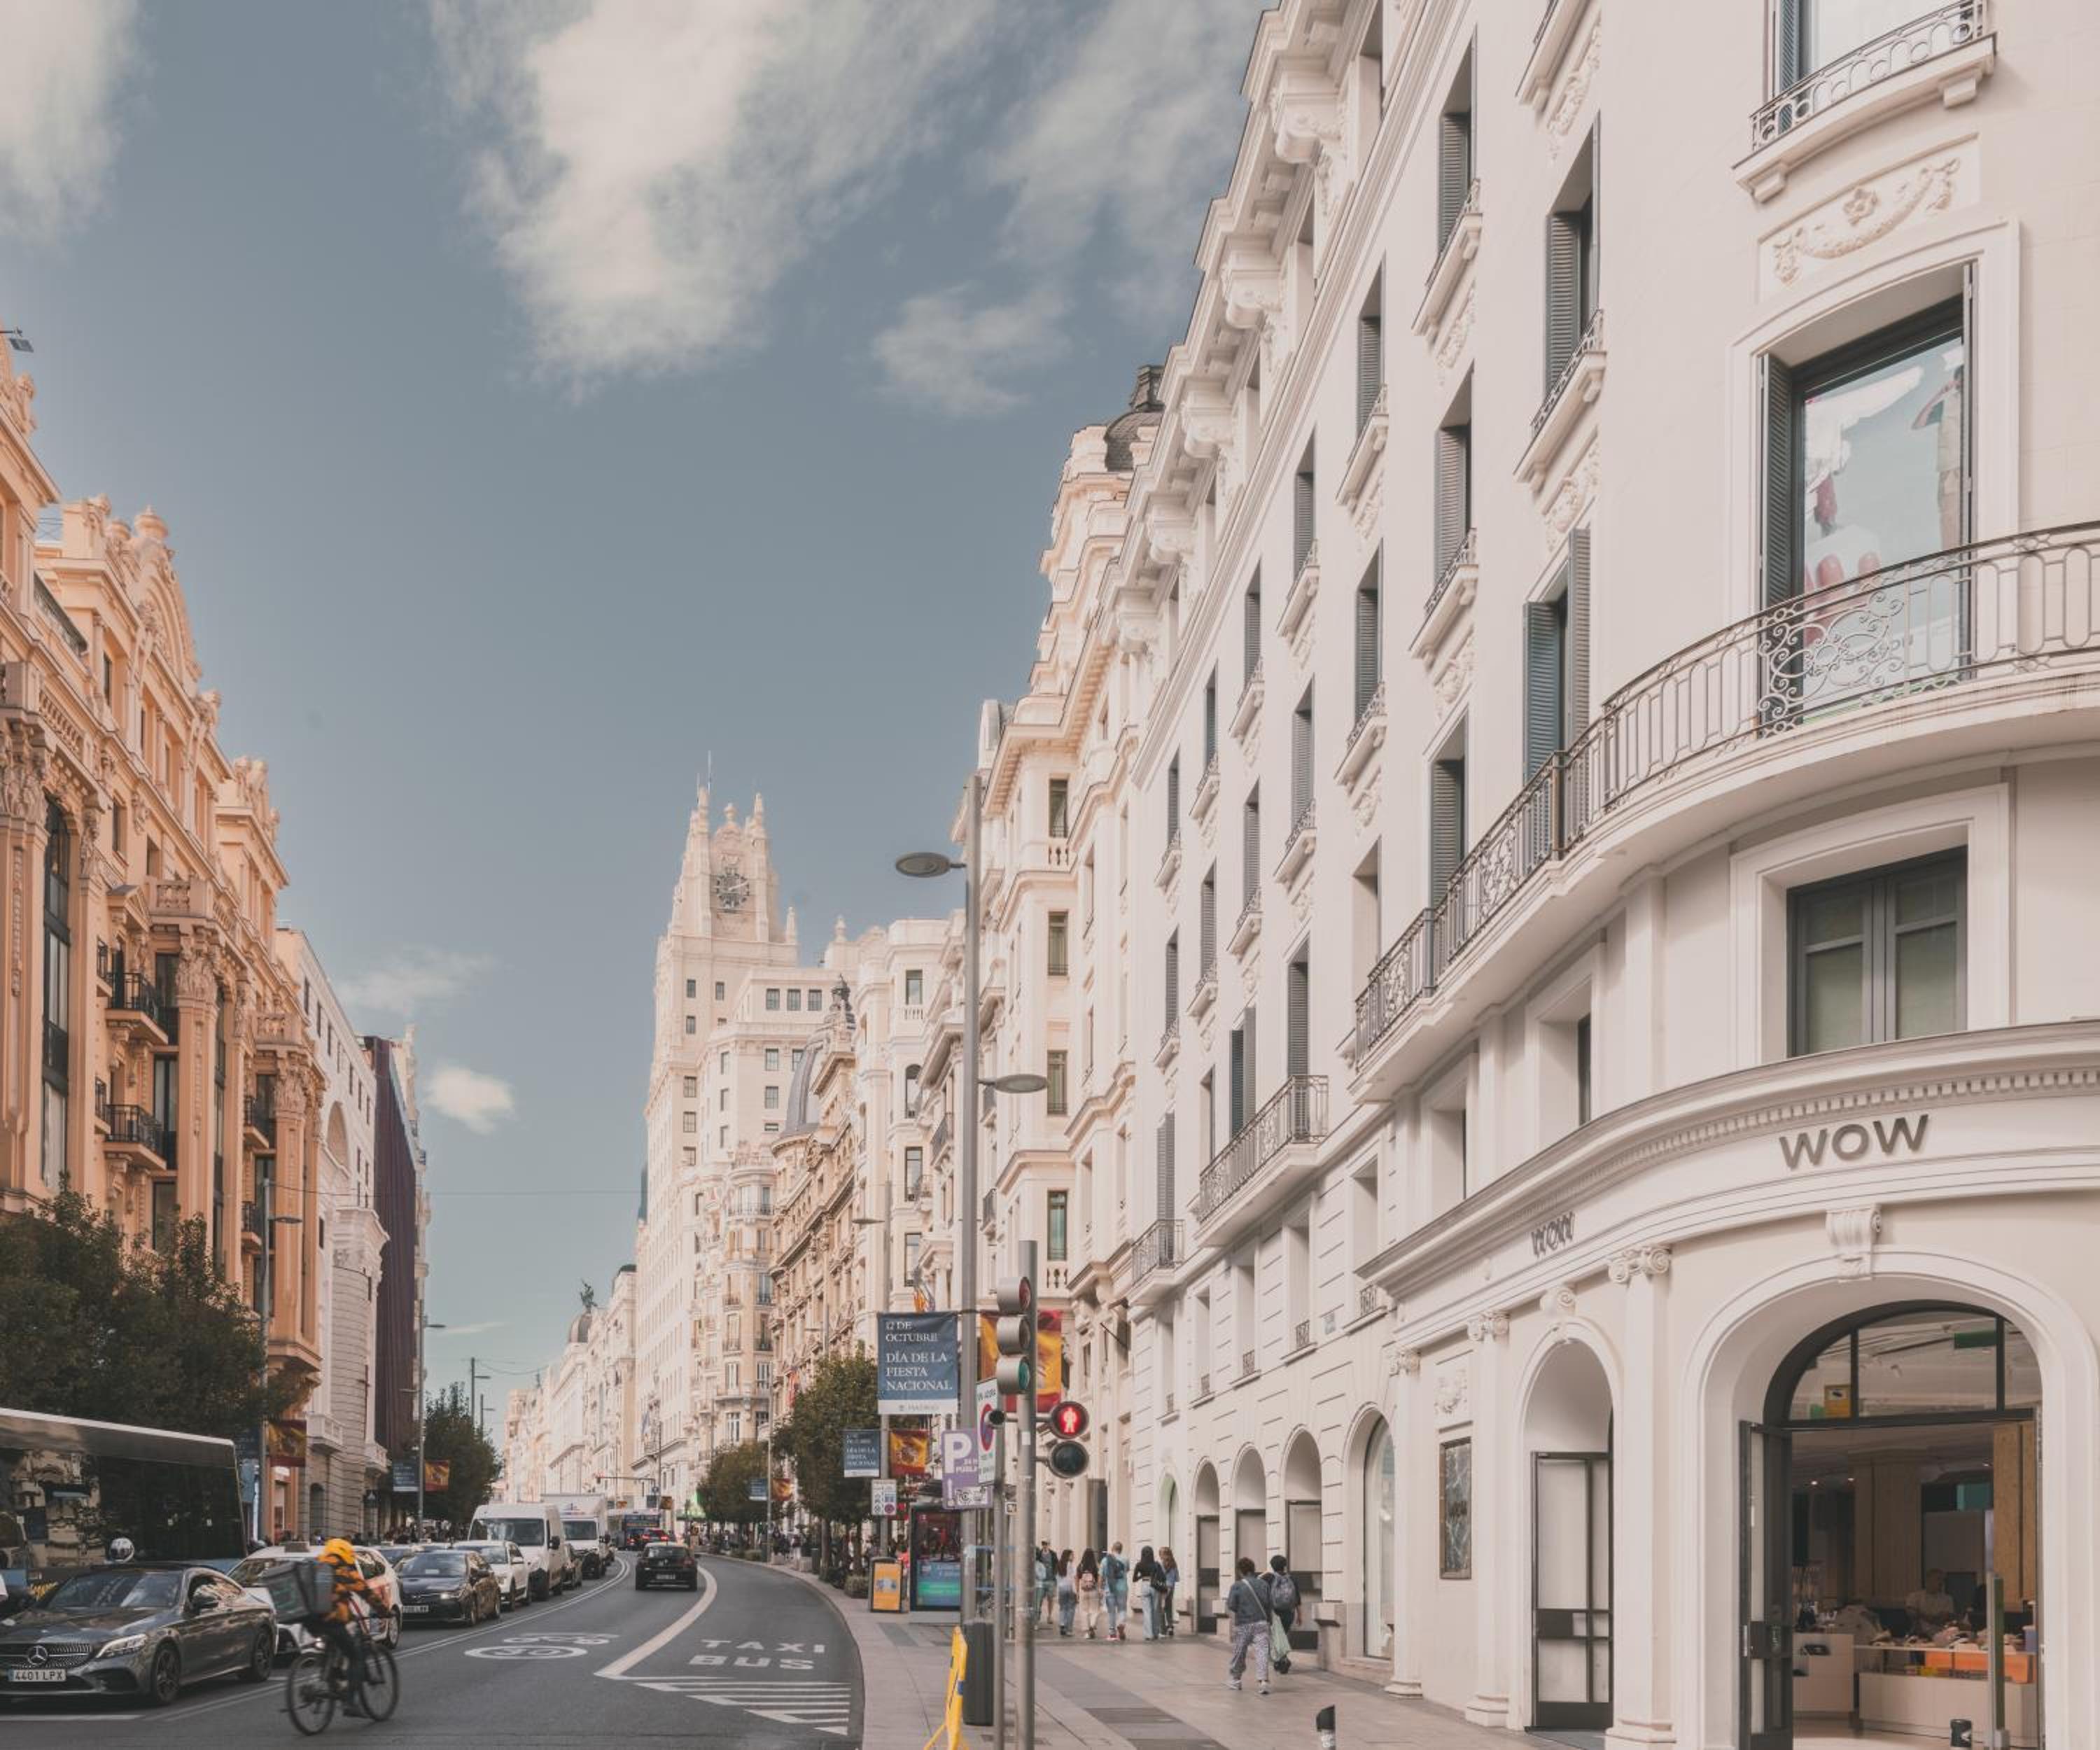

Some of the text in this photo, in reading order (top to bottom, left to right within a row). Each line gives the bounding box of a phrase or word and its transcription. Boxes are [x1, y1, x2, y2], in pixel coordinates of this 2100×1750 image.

[1779, 1114, 1929, 1170] WOW
[1531, 1211, 1575, 1259] WOW
[897, 1321, 912, 1330] DE
[886, 1333, 938, 1342] OCTUBRE
[886, 1350, 947, 1363] DÍA DE LA
[886, 1367, 927, 1377] FIESTA
[886, 1380, 953, 1390] NACIONAL
[945, 1433, 972, 1474] P
[701, 1639, 825, 1653] TAXI
[689, 1656, 814, 1670] BUS
[43, 1671, 62, 1681] LPX
